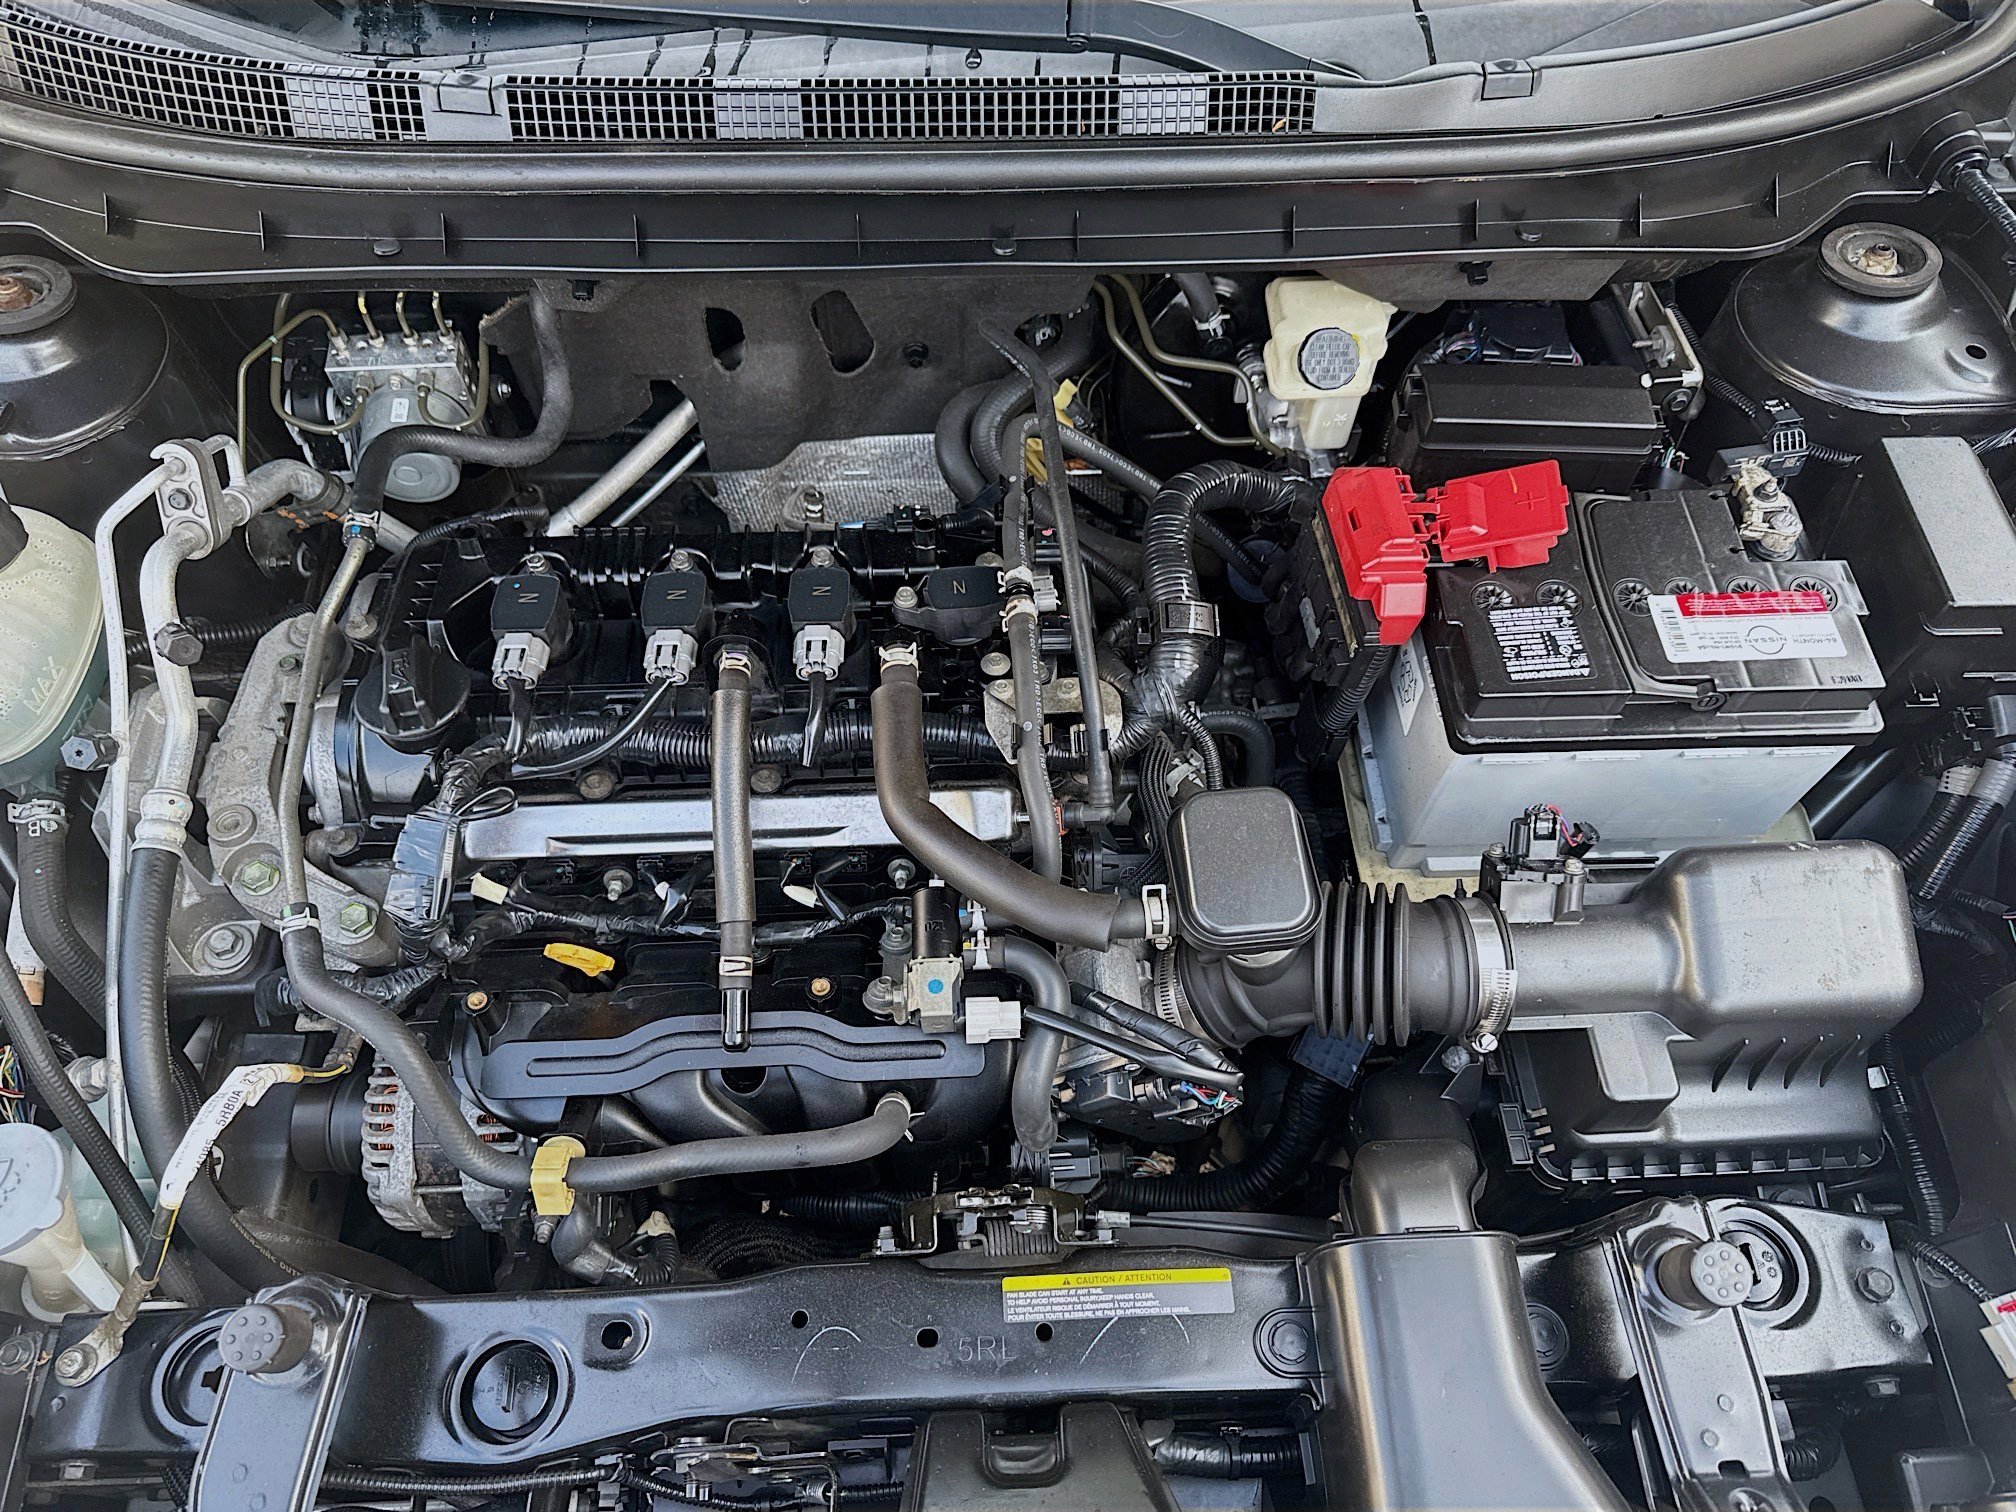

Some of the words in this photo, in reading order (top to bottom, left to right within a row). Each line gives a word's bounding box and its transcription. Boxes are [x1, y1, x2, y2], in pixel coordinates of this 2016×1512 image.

[953, 580, 966, 594] N
[1744, 636, 1787, 644] NISSAN
[1792, 636, 1837, 644] 84-MONTH
[22, 657, 66, 713] MAX
[1076, 1273, 1116, 1285] CAUTION
[1124, 1272, 1172, 1282] ATTENTION
[1049, 1296, 1079, 1304] PERSONAL
[1015, 1305, 1051, 1314] VENTILATEUR
[1125, 1307, 1161, 1315] APPROCHER
[959, 1335, 1017, 1362] 5RL
